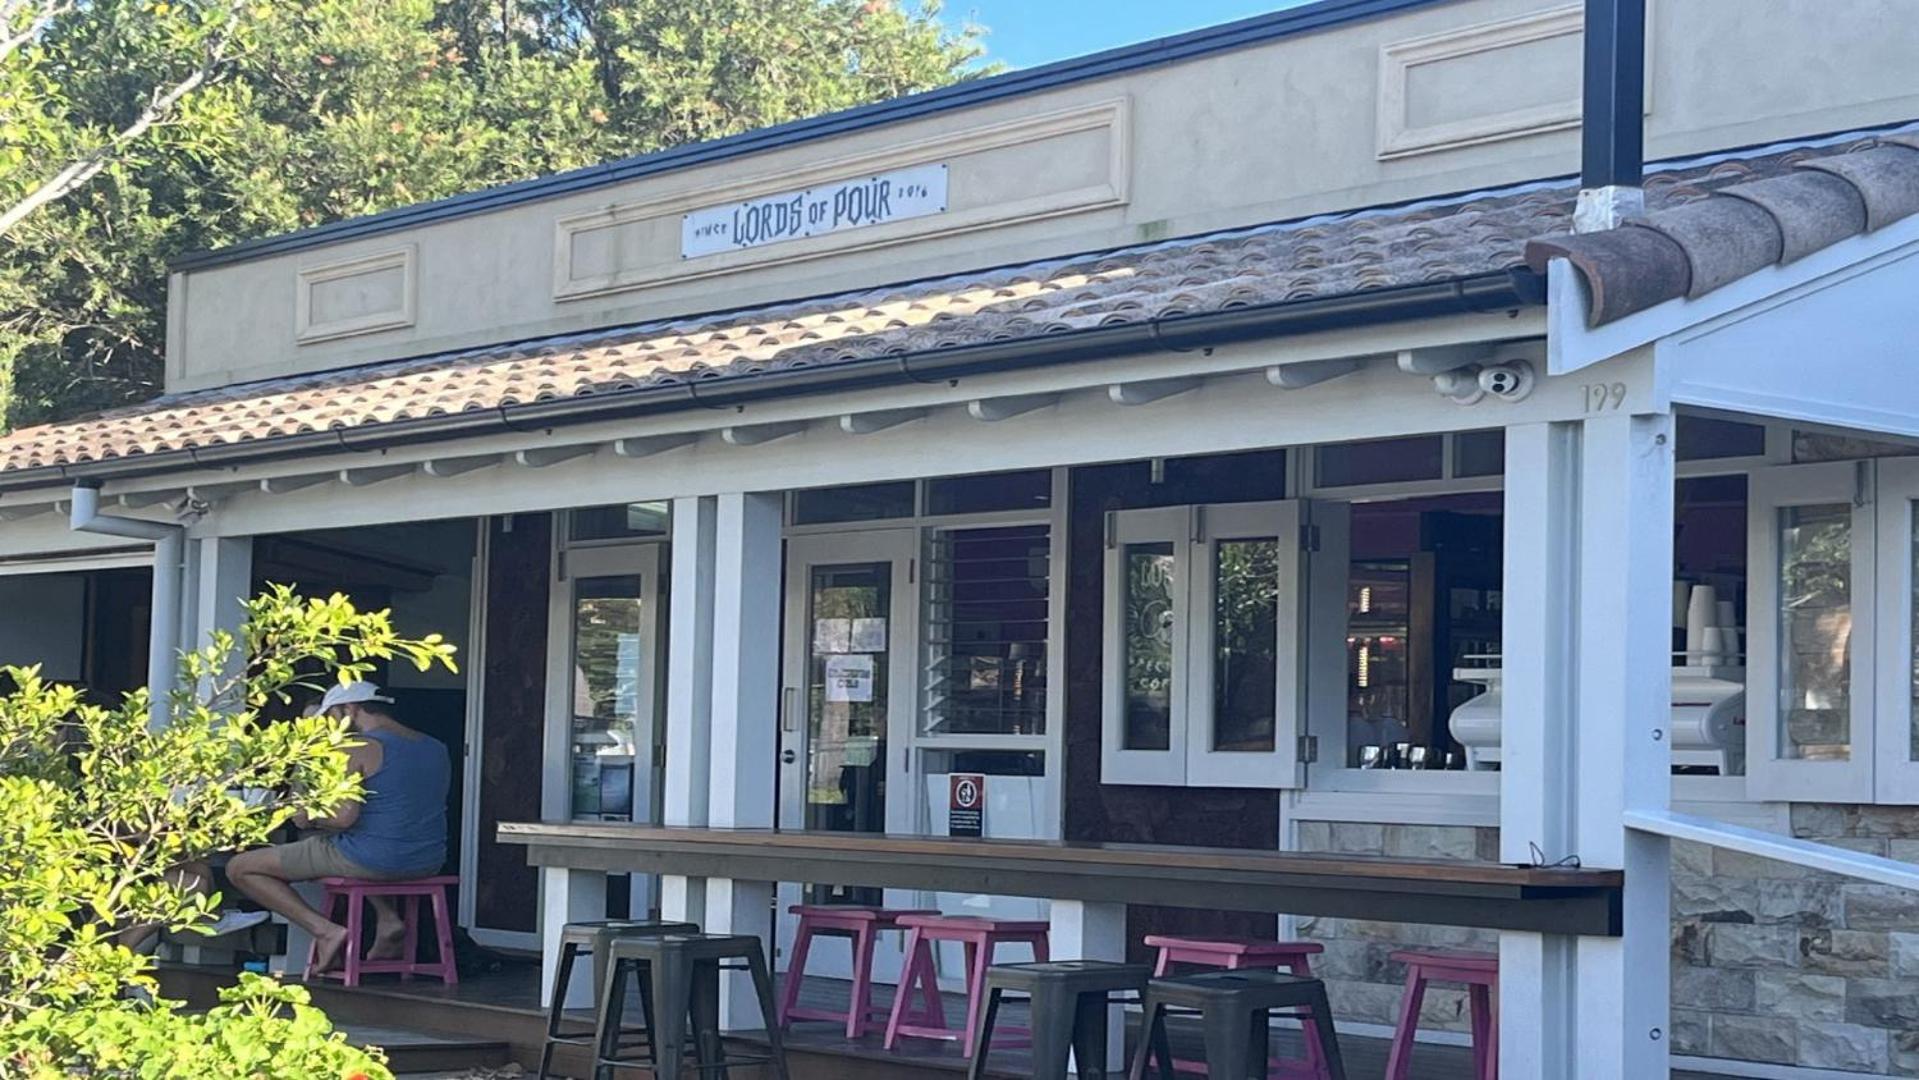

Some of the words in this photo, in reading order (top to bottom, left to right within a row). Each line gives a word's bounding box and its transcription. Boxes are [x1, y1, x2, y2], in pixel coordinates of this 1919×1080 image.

[732, 193, 803, 245] LORDS
[808, 200, 828, 225] OF
[833, 180, 891, 228] POUR
[1579, 382, 1627, 413] 199
